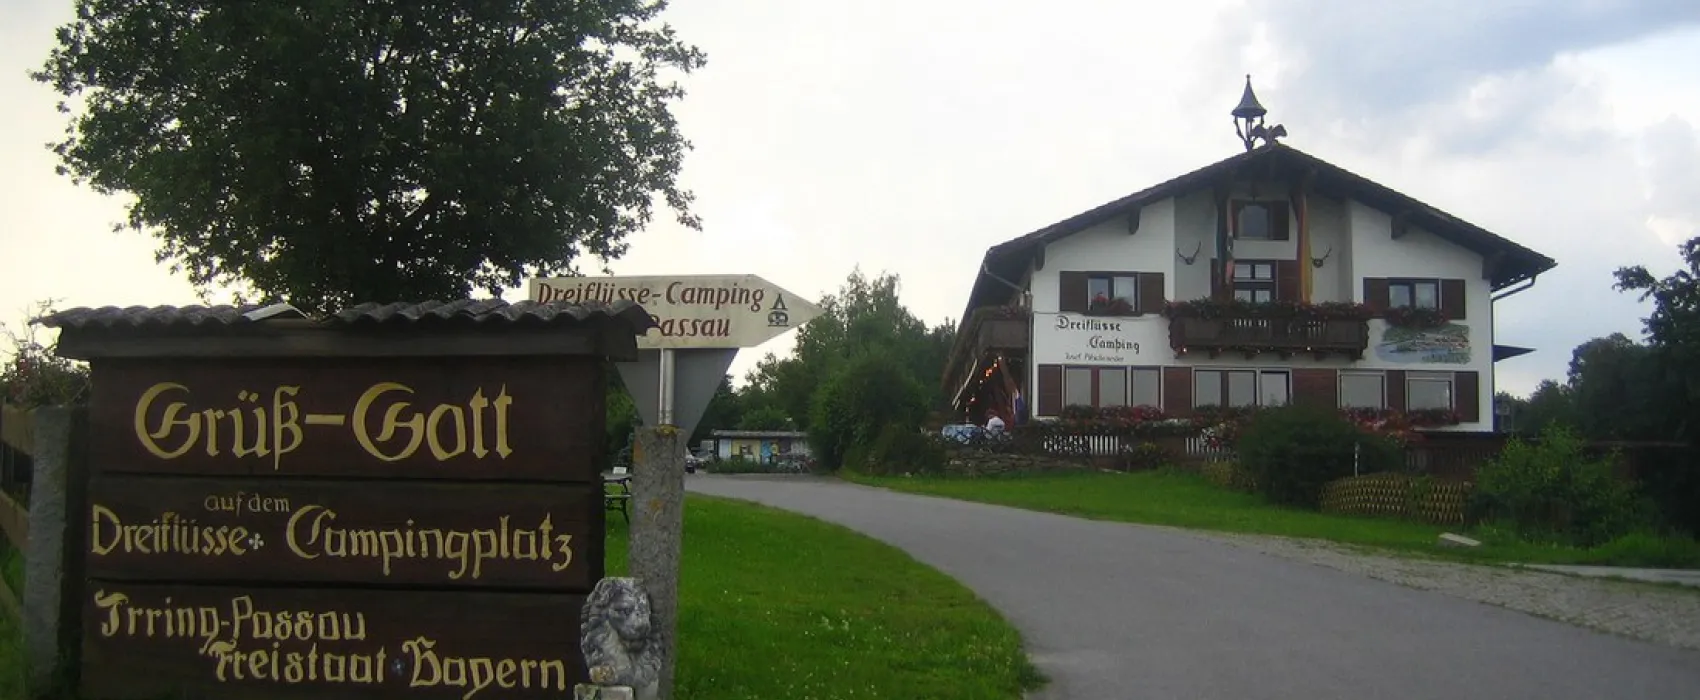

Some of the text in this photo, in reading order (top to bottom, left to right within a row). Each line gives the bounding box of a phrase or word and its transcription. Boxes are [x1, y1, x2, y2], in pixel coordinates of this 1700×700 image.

[1088, 335, 1140, 354] Camping
[134, 381, 514, 471] Grüß-Gott
[203, 492, 290, 518] auf dem
[91, 503, 574, 580] Dreiflüsse Campingplatz
[206, 635, 566, 700] Freistaat Bayern
